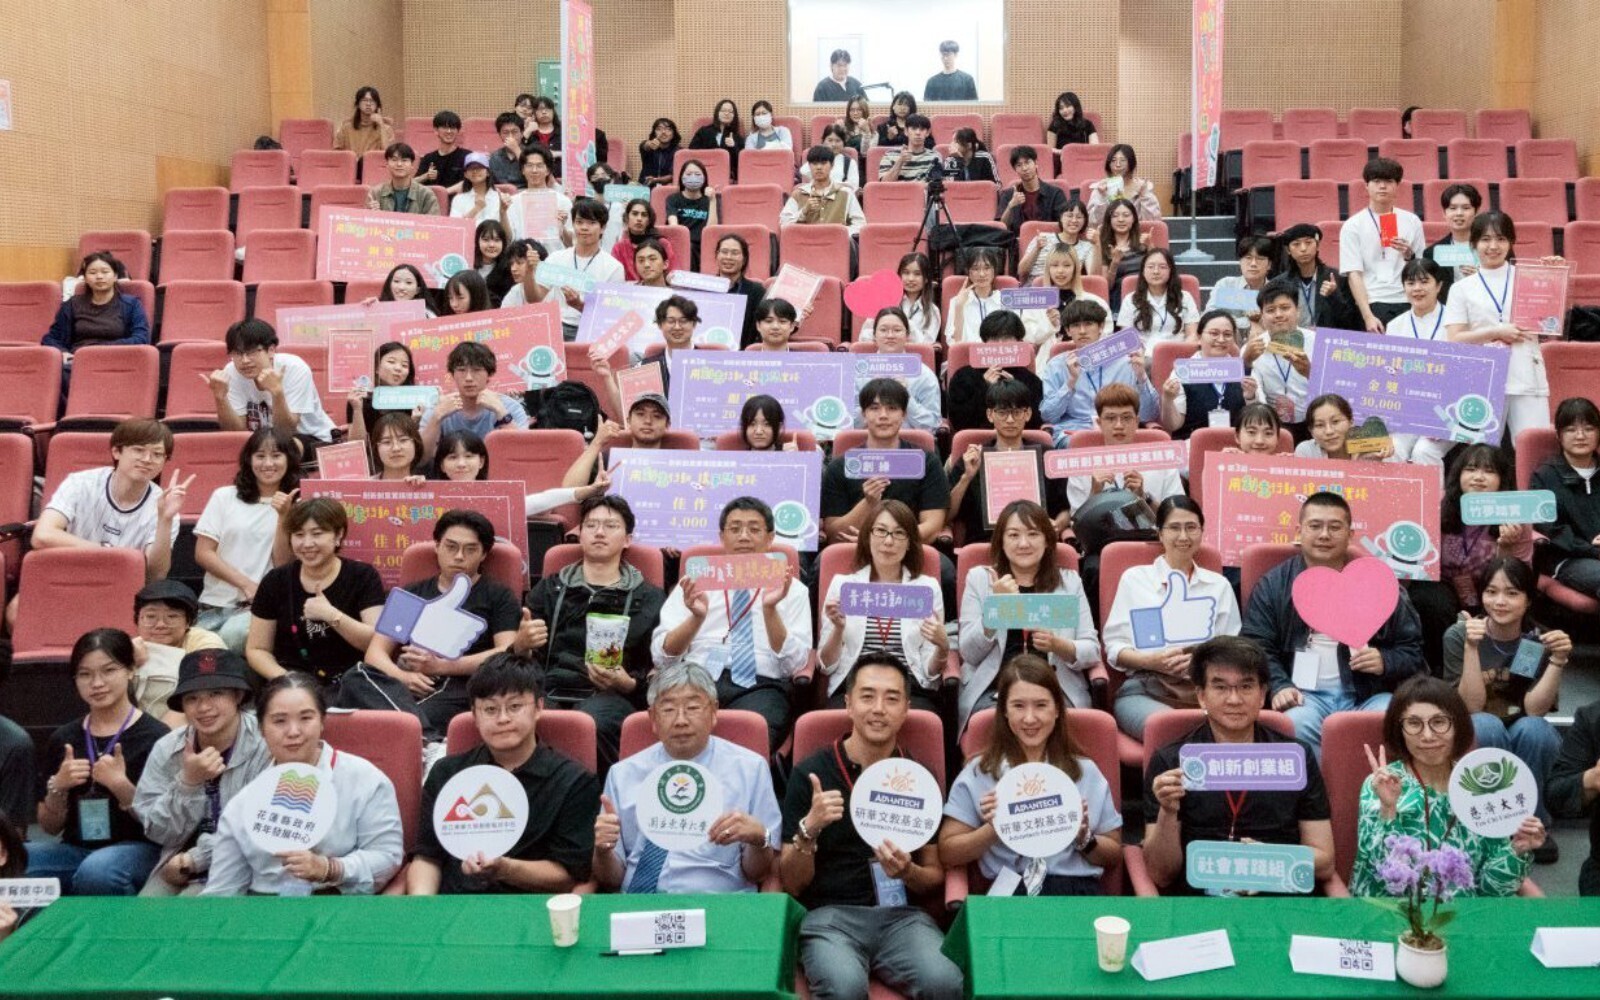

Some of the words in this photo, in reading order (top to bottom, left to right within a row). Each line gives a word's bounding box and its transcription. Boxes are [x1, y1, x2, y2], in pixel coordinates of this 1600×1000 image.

[869, 363, 905, 372] AIRDSS
[1190, 368, 1229, 378] MedVox
[1360, 396, 1402, 412] 30,000
[1228, 475, 1296, 499] 用創意行動
[396, 504, 444, 524] 讓夢想實
[670, 516, 708, 528] 4,000
[374, 534, 409, 548] 佳作
[374, 556, 403, 568] 4,00
[1208, 758, 1296, 777] 創新創業組
[874, 793, 920, 808] ADVANTECH
[1014, 798, 1059, 814] ADVANTECH
[1470, 792, 1526, 820] 慈濟大學
[257, 810, 316, 832] 花蓮縣政府
[855, 807, 934, 830] 研華文教基金會
[1000, 811, 1078, 834] 研華文教基金會
[252, 822, 311, 844] 青年發展中心
[1196, 856, 1285, 878] 社會實踐組
